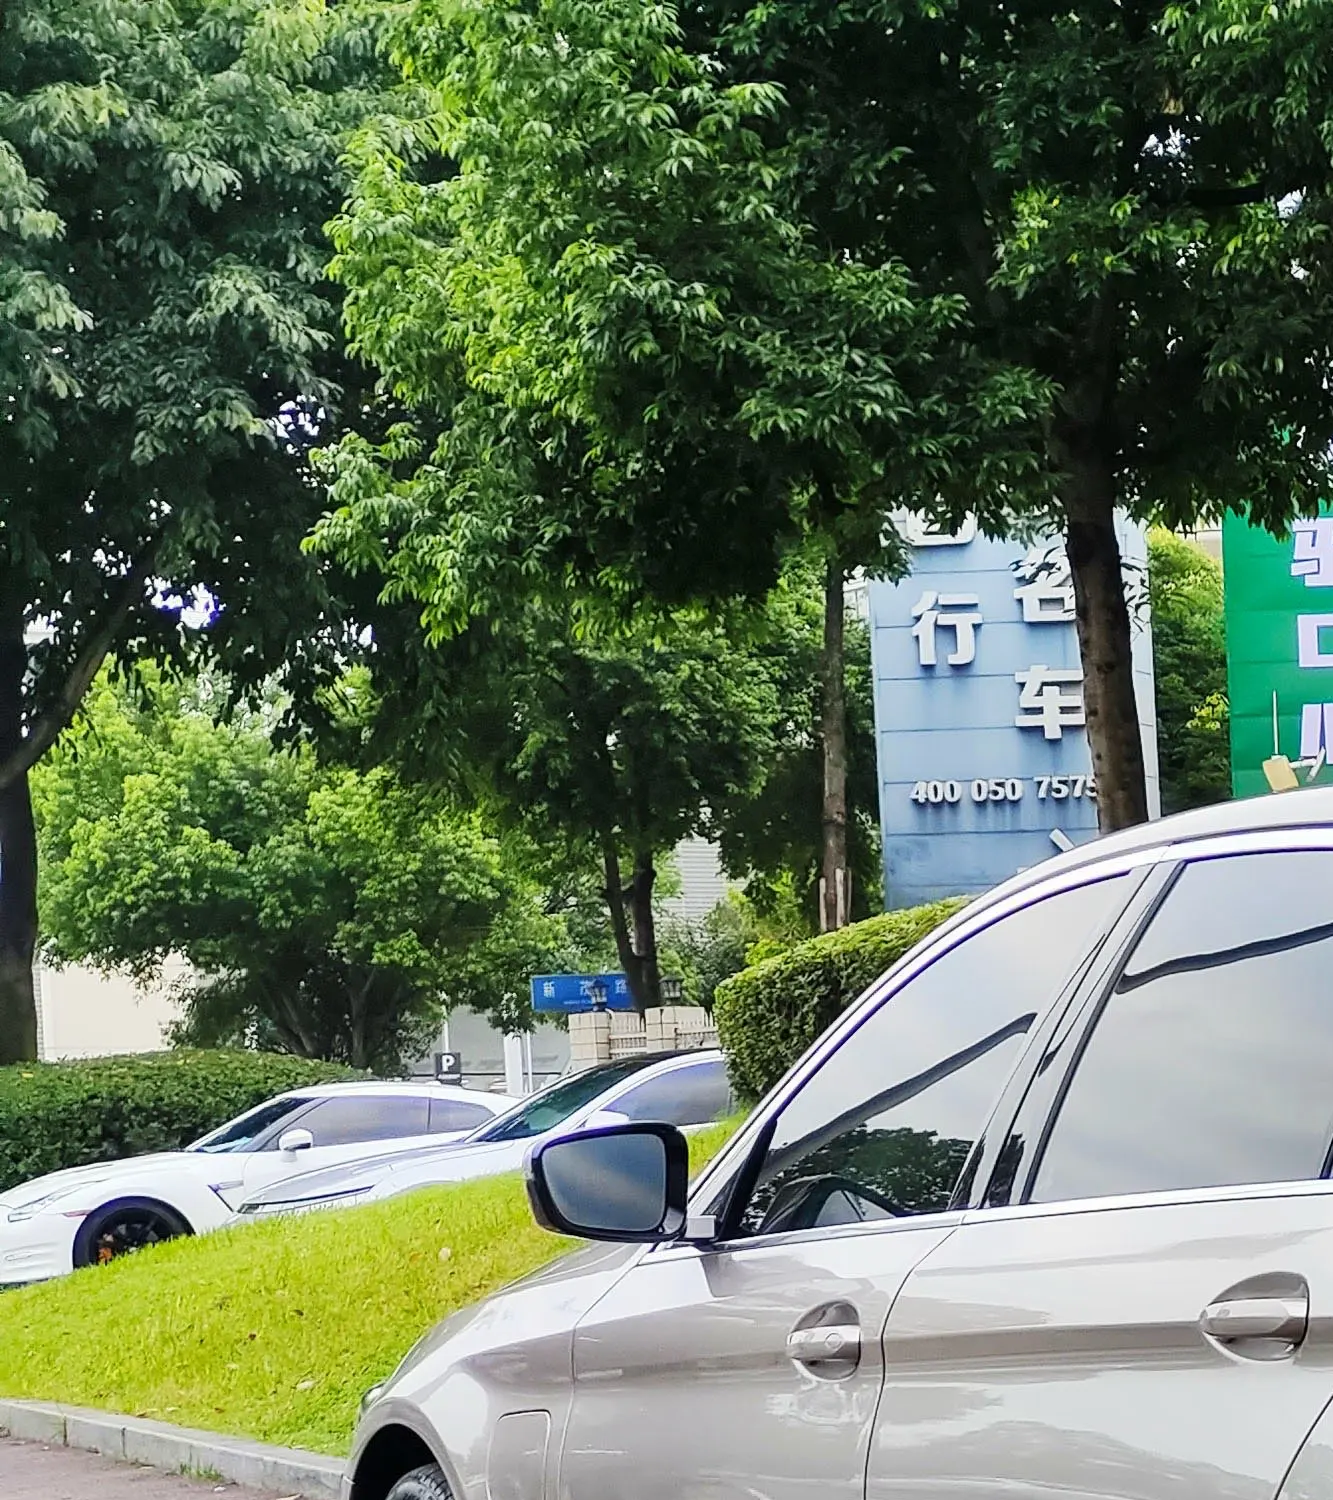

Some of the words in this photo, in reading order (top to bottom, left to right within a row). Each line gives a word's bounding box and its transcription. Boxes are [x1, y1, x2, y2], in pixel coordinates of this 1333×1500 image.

[909, 780, 962, 805] 400
[970, 778, 1023, 803] 050
[1032, 774, 1098, 800] 7575
[441, 1054, 456, 1072] P
